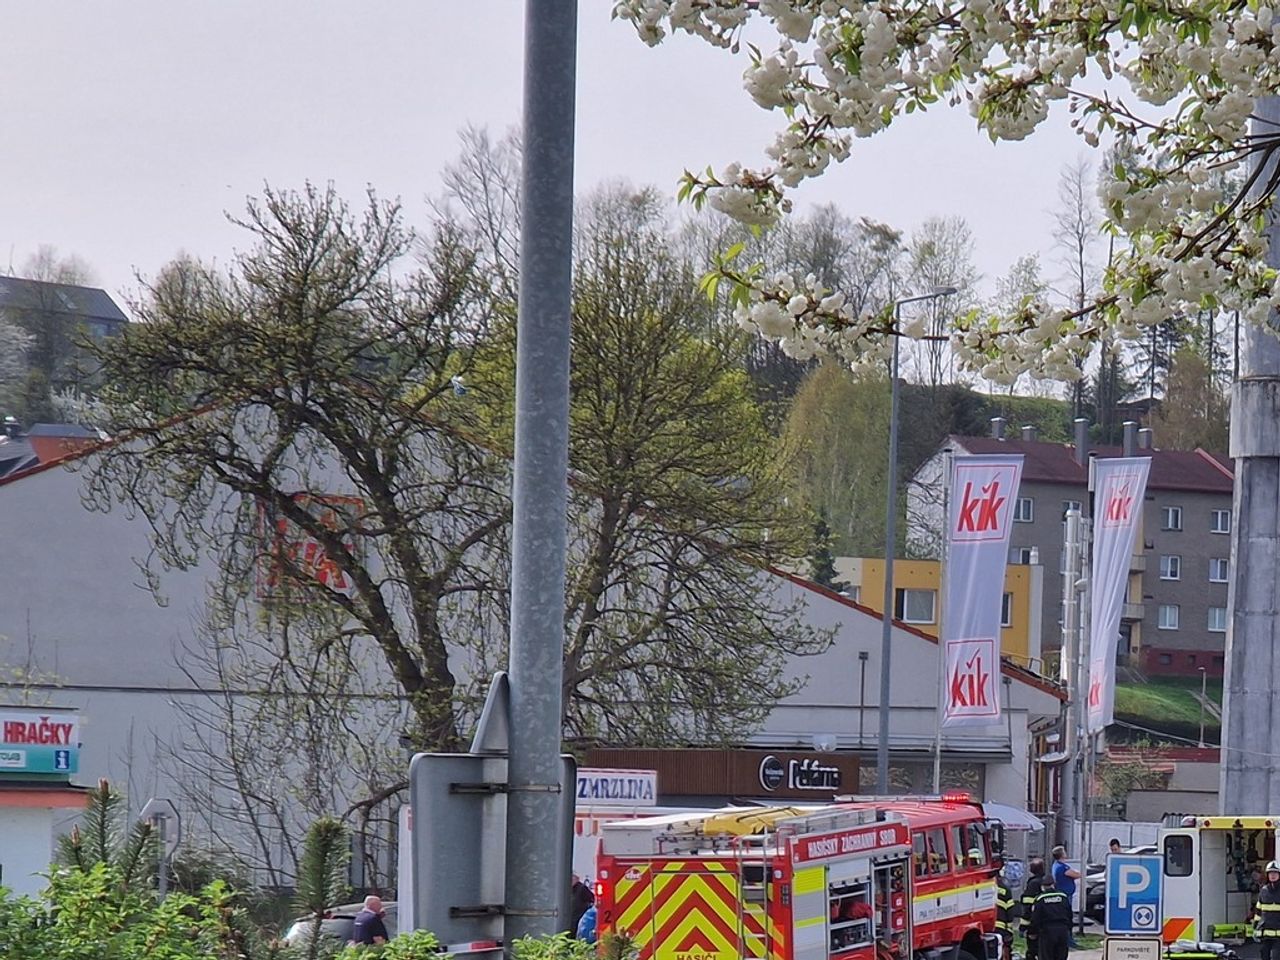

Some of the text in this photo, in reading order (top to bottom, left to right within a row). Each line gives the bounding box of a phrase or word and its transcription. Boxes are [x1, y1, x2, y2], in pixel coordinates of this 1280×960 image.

[3, 716, 74, 745] HRAČKY
[578, 778, 653, 799] ZMRZLINA
[1118, 864, 1150, 908] P
